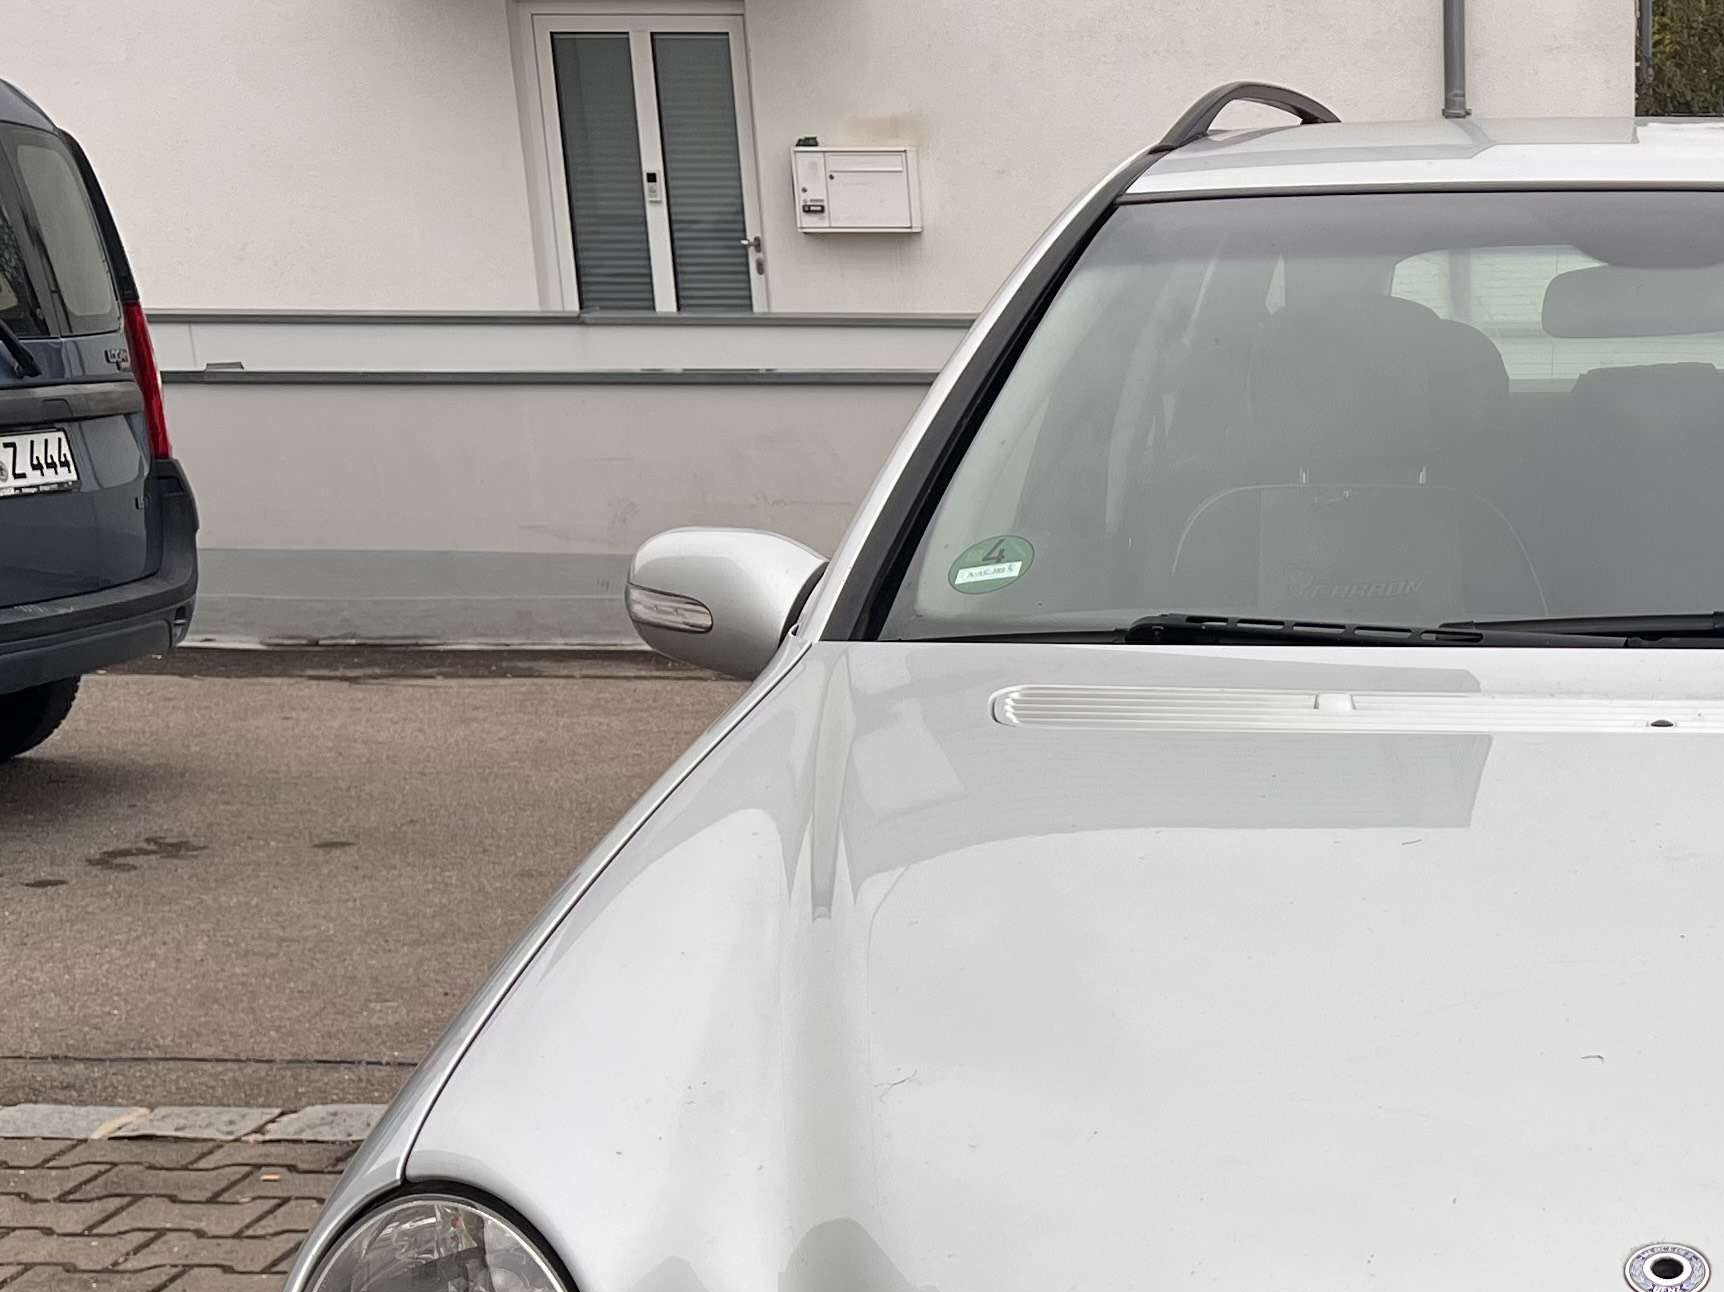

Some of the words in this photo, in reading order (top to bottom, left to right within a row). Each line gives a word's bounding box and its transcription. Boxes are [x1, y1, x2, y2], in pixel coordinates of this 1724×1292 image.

[2, 441, 27, 480] Z
[30, 436, 72, 477] 444
[982, 538, 1006, 563] 4
